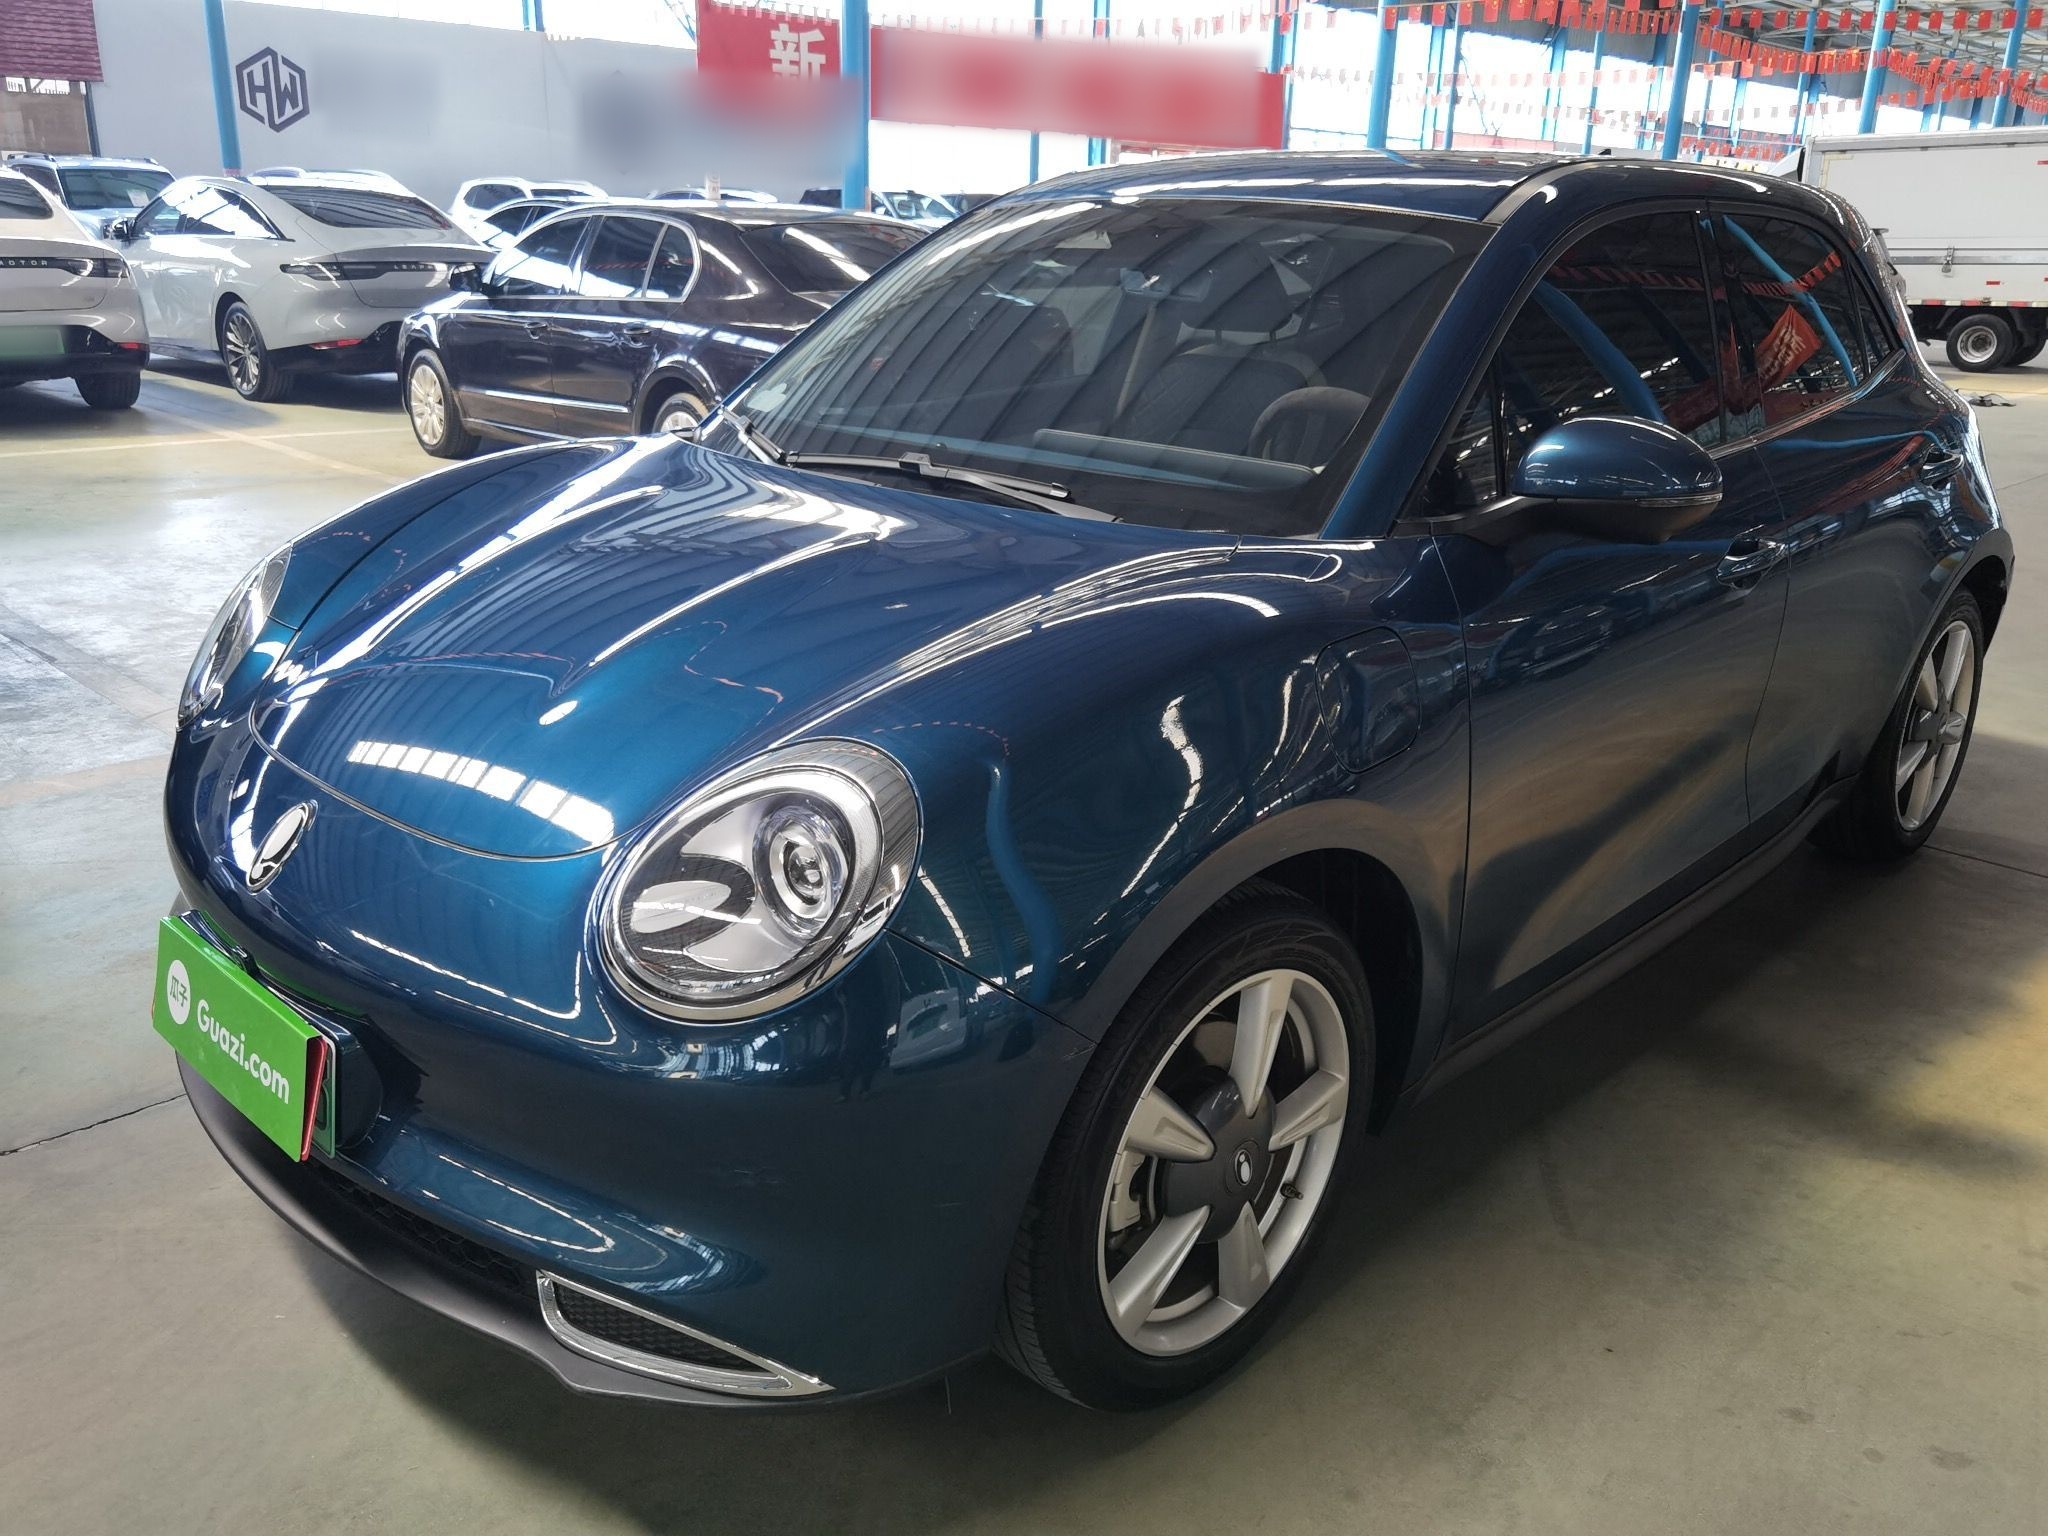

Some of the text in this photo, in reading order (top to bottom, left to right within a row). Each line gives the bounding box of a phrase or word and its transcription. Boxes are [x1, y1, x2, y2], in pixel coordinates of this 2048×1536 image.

[244, 58, 301, 120] HW
[169, 975, 188, 1007] 瓜子
[197, 999, 290, 1105] Guazi.com
